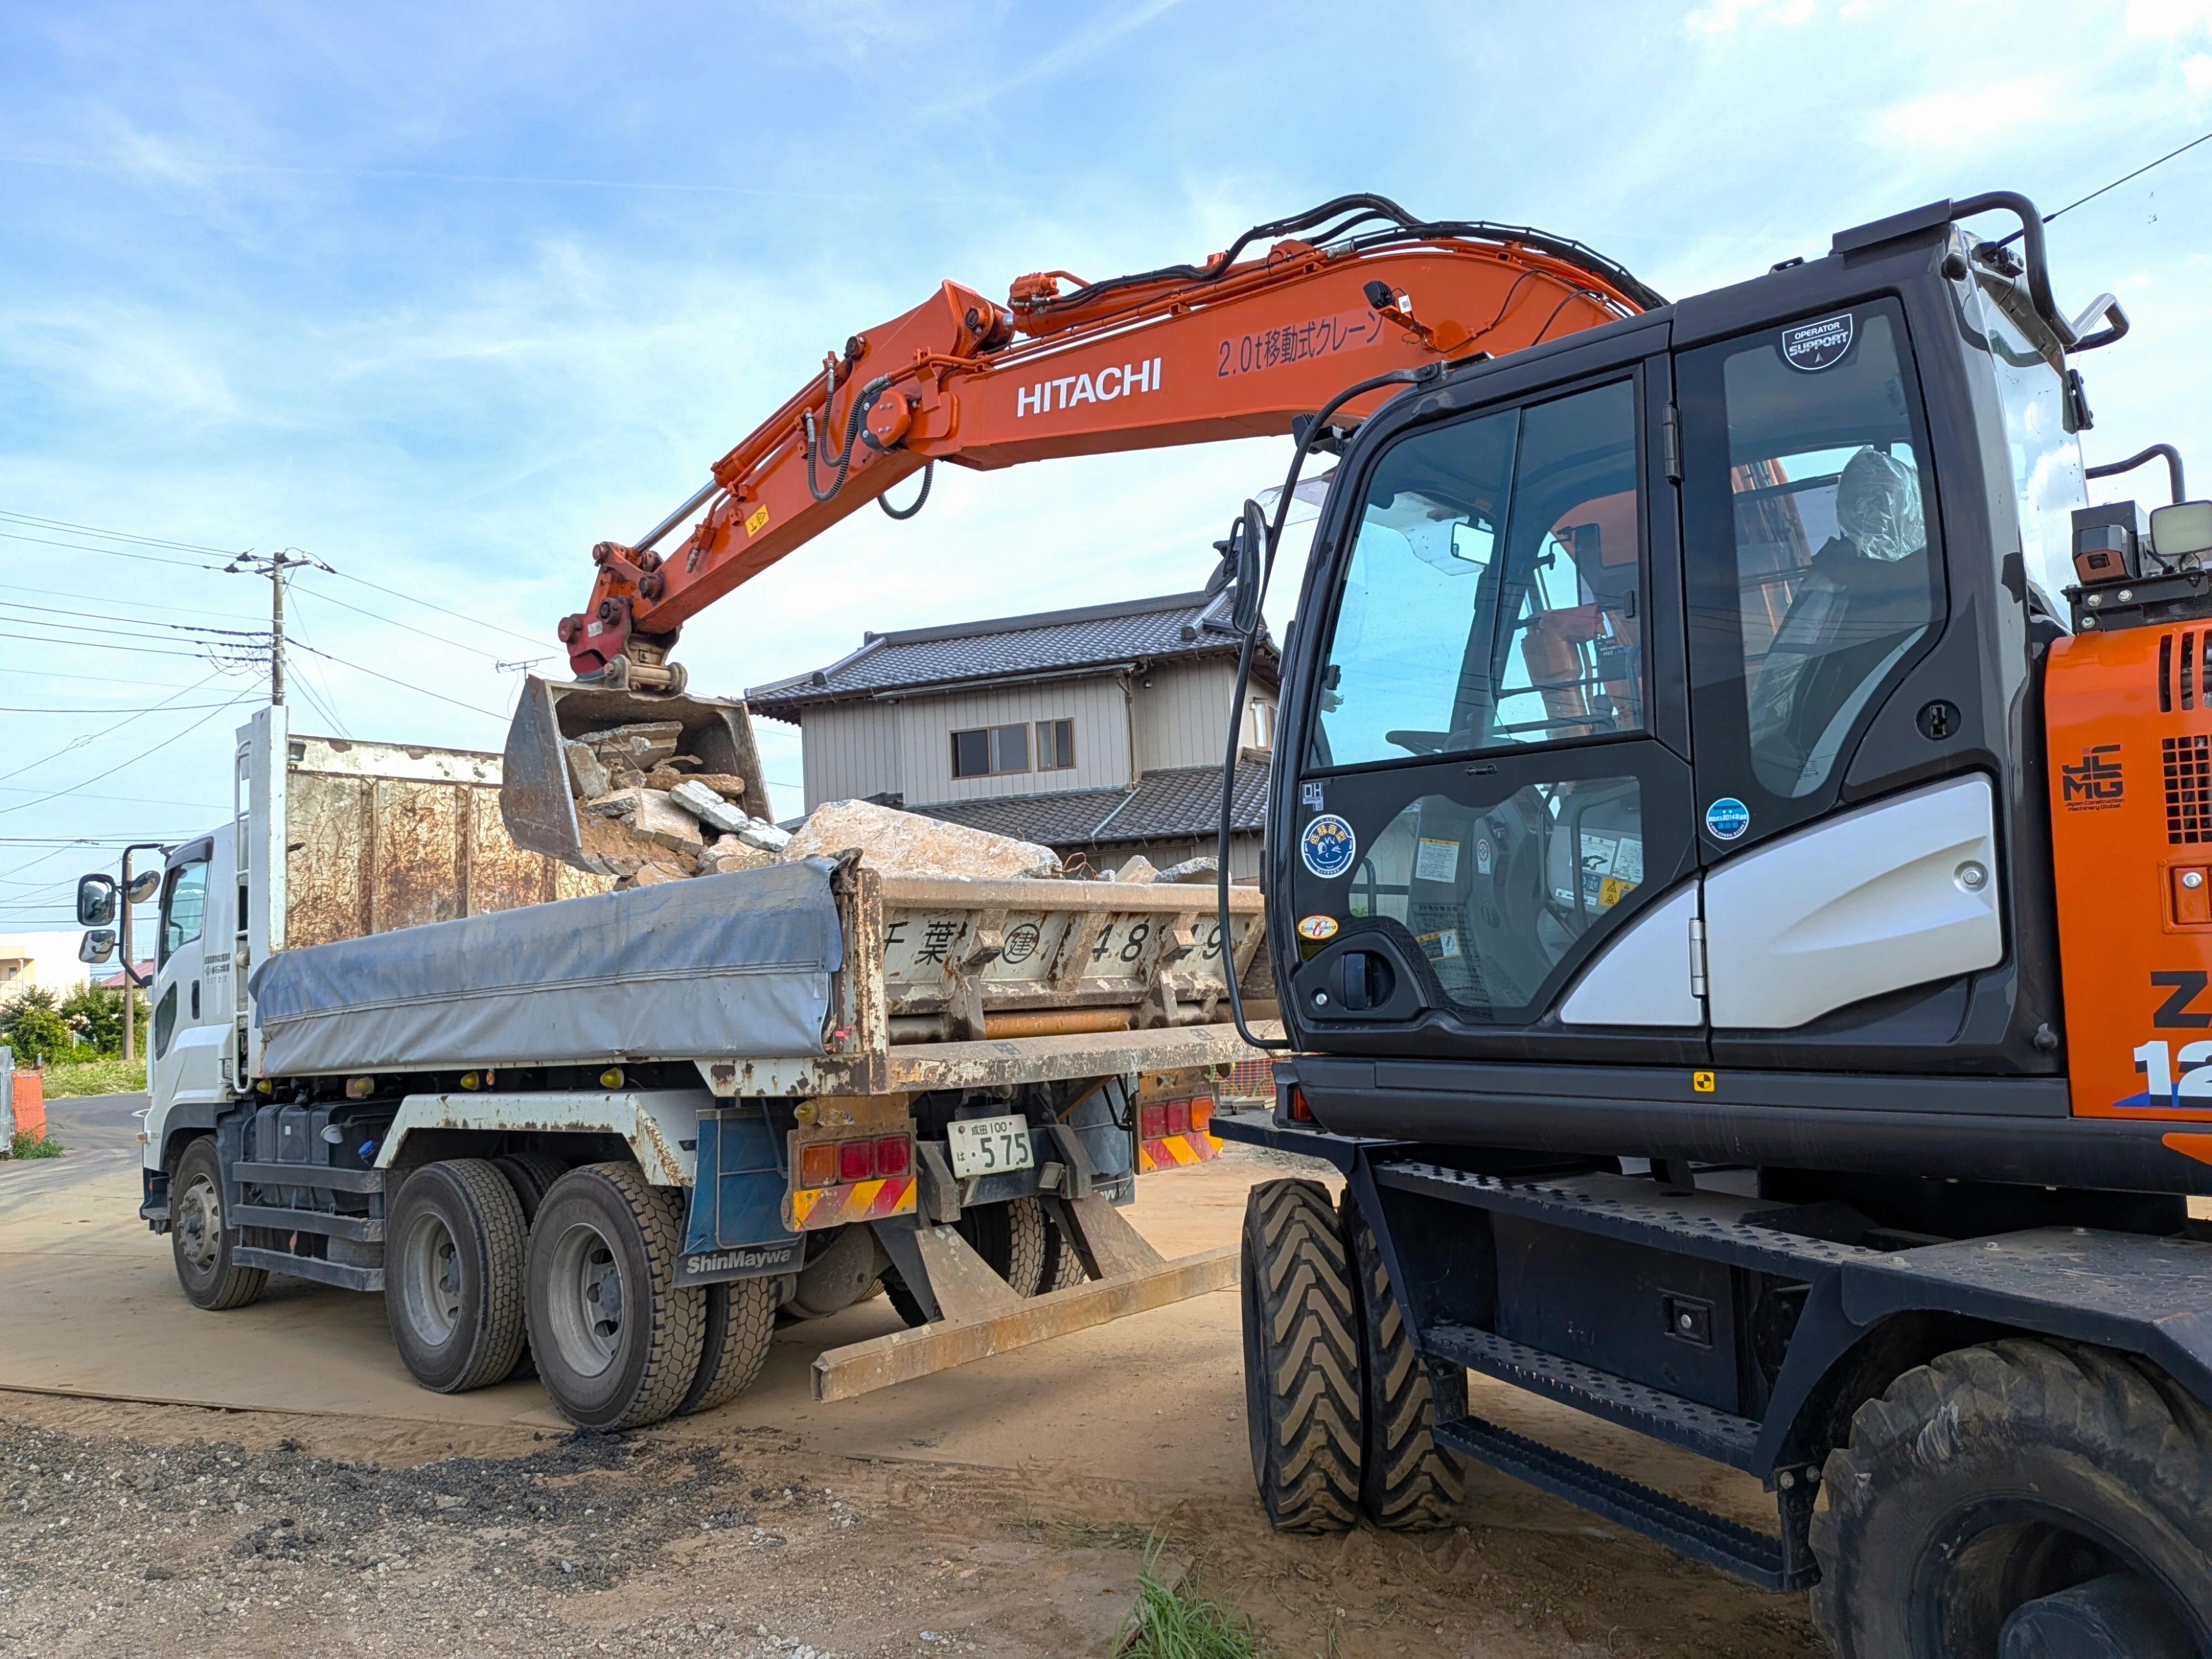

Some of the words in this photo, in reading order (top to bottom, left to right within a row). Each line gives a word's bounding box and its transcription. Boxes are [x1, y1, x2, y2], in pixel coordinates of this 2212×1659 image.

[1794, 322, 1840, 340] OPERATOR
[1218, 311, 1383, 377] 2.0t移動式クレーン
[1790, 332, 1848, 356] SUPPORT
[1017, 358, 1161, 417] HITACHI
[686, 1249, 791, 1274] ShinMaywa
